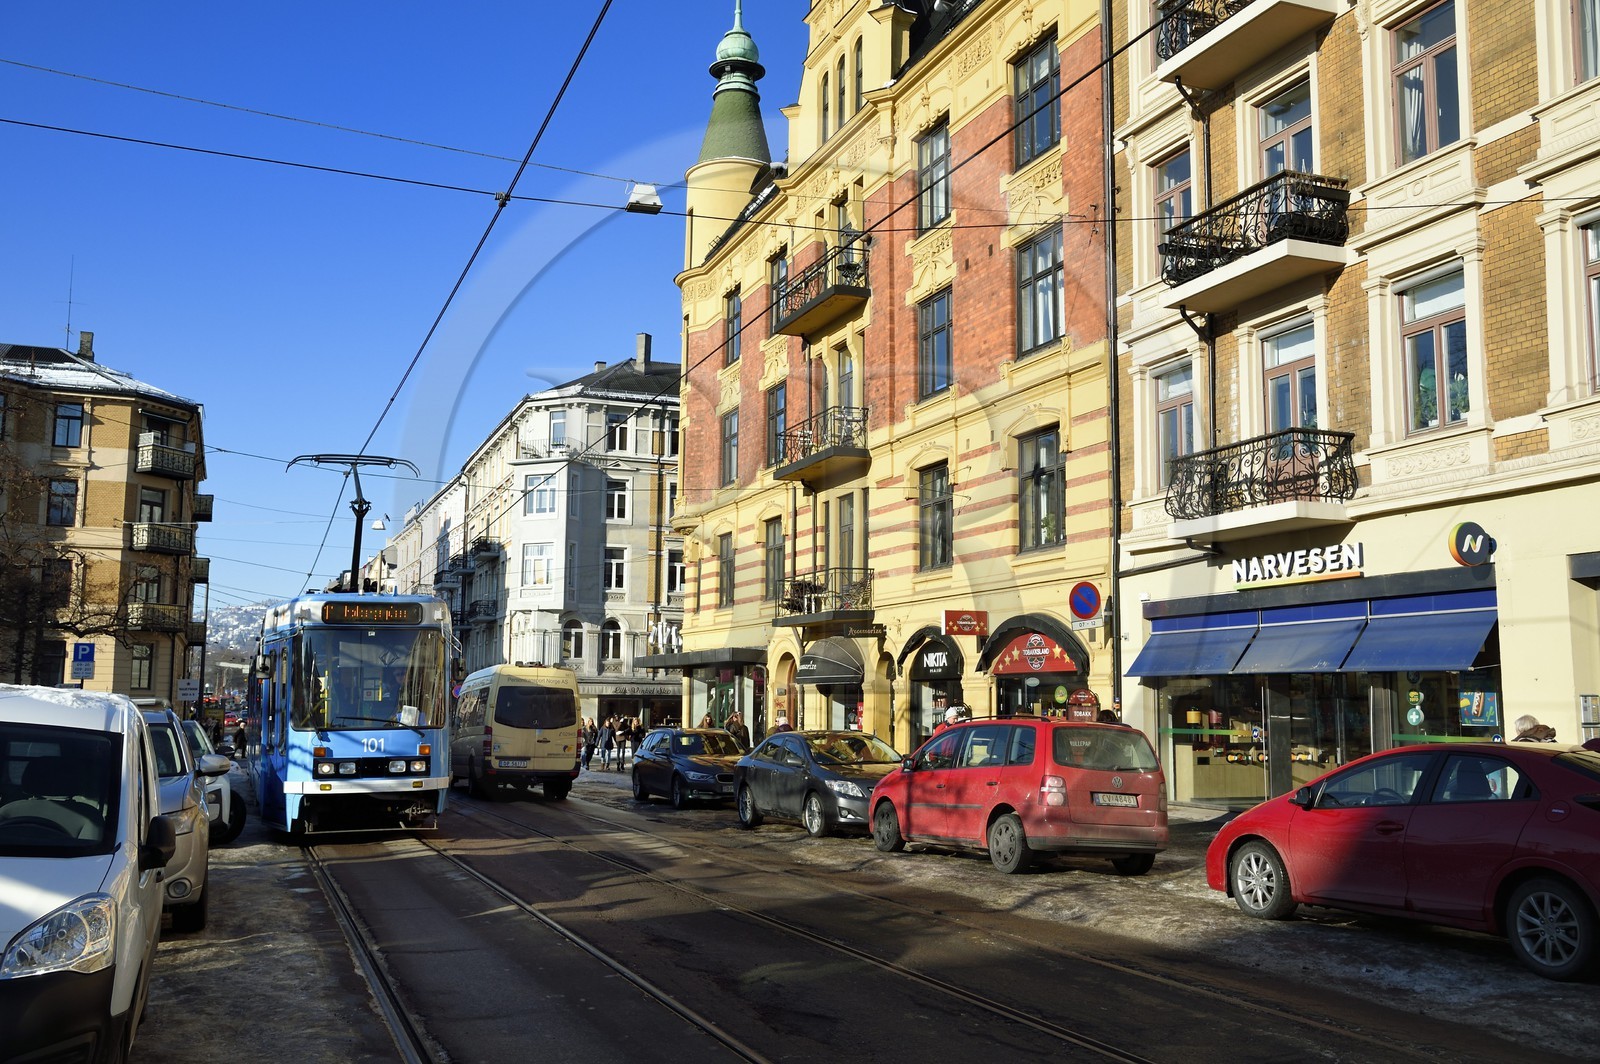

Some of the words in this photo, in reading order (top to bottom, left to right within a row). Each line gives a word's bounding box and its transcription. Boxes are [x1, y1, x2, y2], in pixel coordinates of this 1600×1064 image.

[1462, 534, 1484, 553] N
[1231, 541, 1362, 582] NARVESEN
[848, 625, 882, 636] Accessorize
[78, 645, 90, 660] P
[1022, 647, 1050, 656] TOBAKKSLAND
[923, 652, 948, 668] NIKITA
[656, 686, 672, 694] Sko
[361, 737, 385, 753] 101
[1101, 794, 1111, 803] CV
